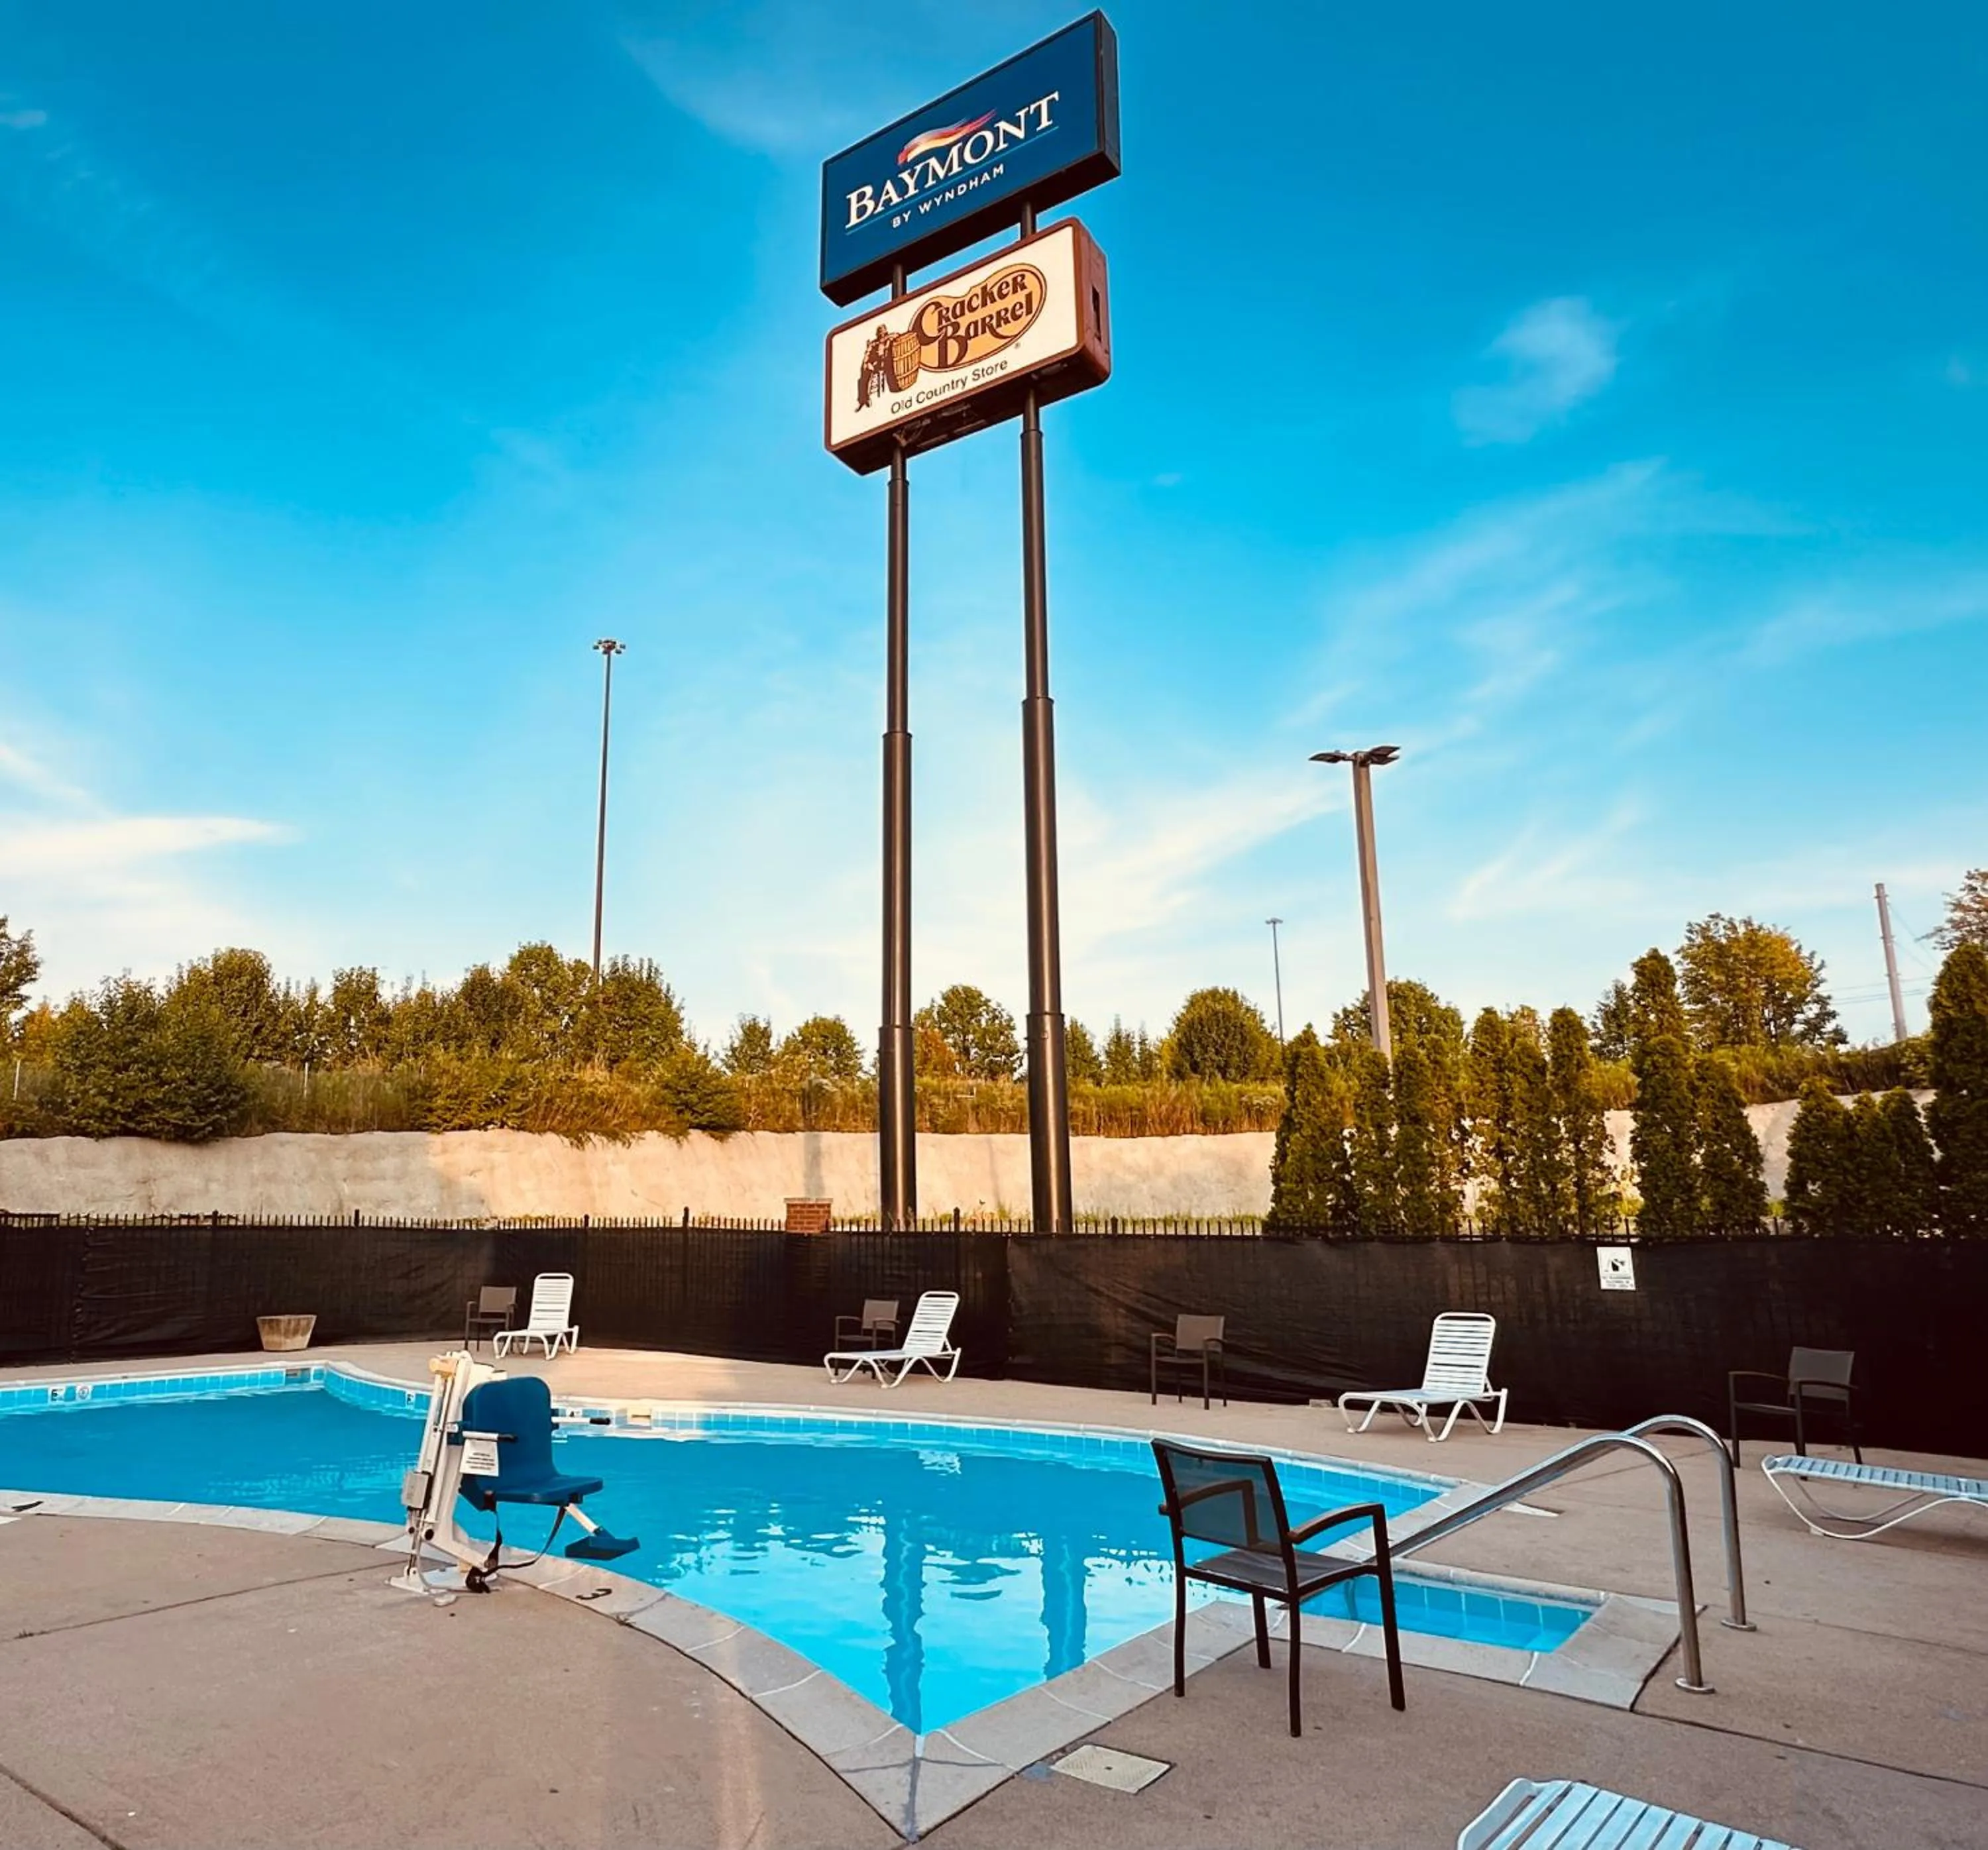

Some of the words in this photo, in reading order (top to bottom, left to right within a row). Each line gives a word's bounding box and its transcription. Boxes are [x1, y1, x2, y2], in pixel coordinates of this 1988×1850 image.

[845, 91, 1060, 229] BAYMONT
[891, 211, 911, 229] BY
[918, 164, 1005, 215] WYNDHAM
[891, 398, 912, 415] Old
[916, 376, 968, 405] Country
[971, 360, 1009, 382] Store
